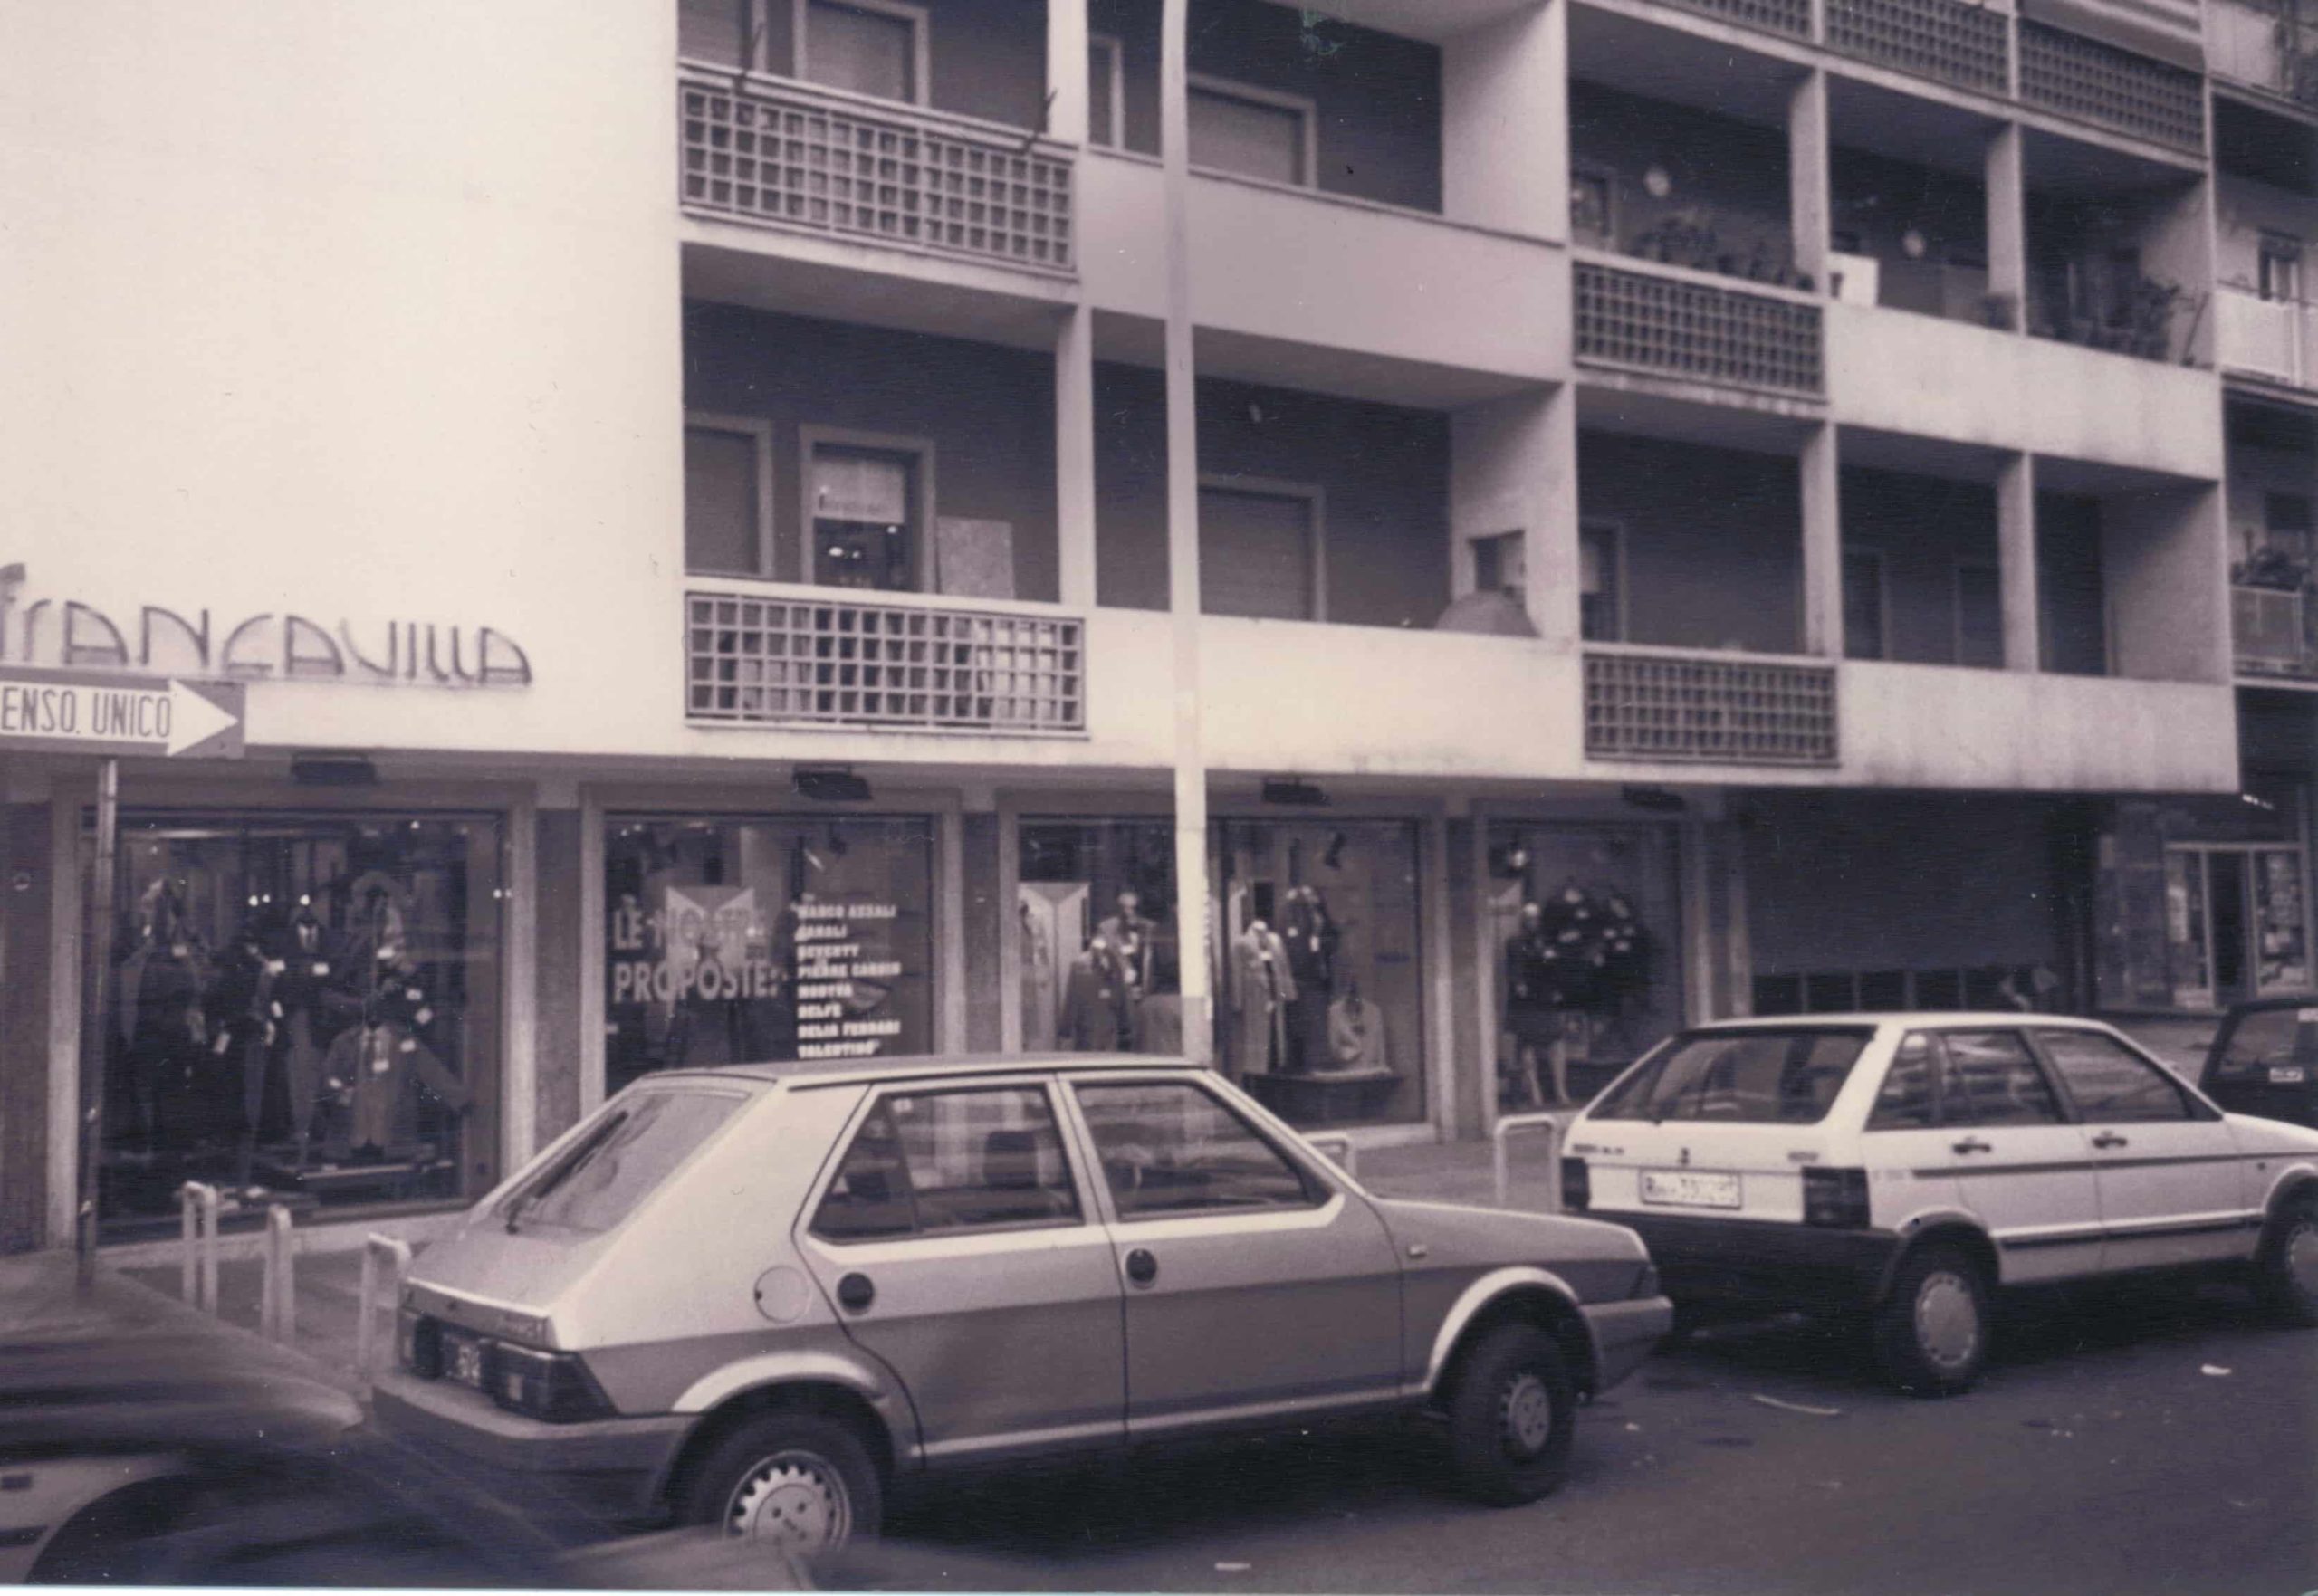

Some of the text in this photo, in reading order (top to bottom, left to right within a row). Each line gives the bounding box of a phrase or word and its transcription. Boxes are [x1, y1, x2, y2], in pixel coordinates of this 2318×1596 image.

[0, 684, 172, 739] ENSO. UNICO
[614, 907, 643, 951] LE
